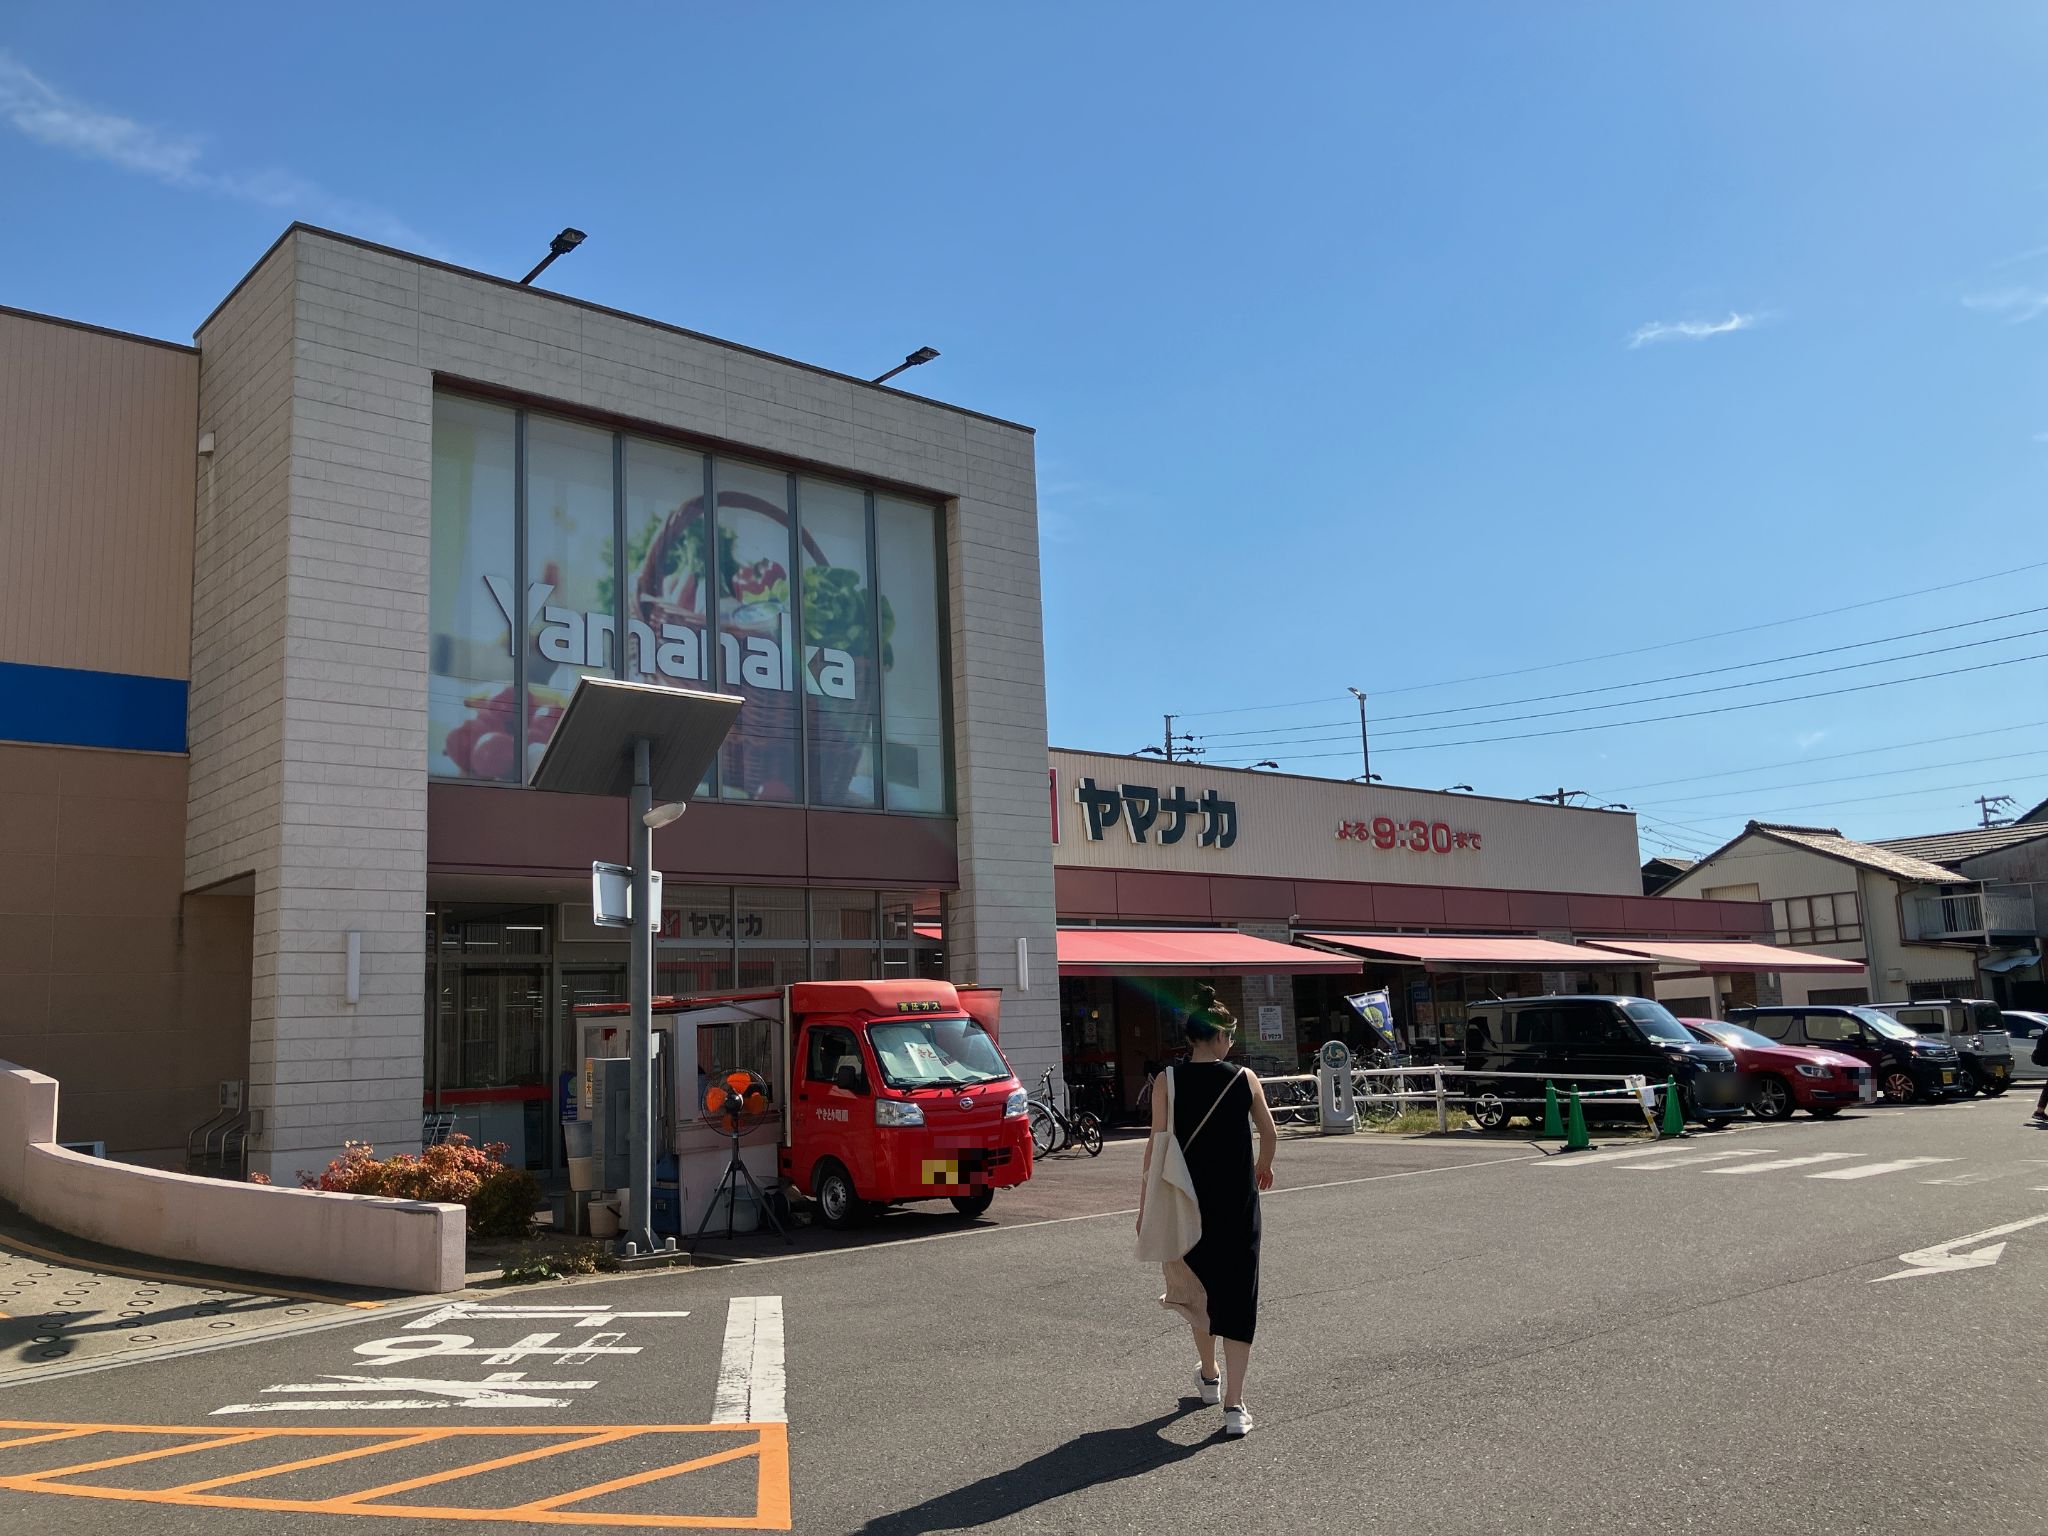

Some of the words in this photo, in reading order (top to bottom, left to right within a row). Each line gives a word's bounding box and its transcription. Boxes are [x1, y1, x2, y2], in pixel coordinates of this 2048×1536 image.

[483, 575, 856, 700] Yamanaka
[1075, 777, 1238, 850] ヤマナカ
[689, 912, 763, 937] ヤマナカ
[900, 1001, 940, 1012] 高圧ガス
[207, 1301, 691, 1415] 止まれ
